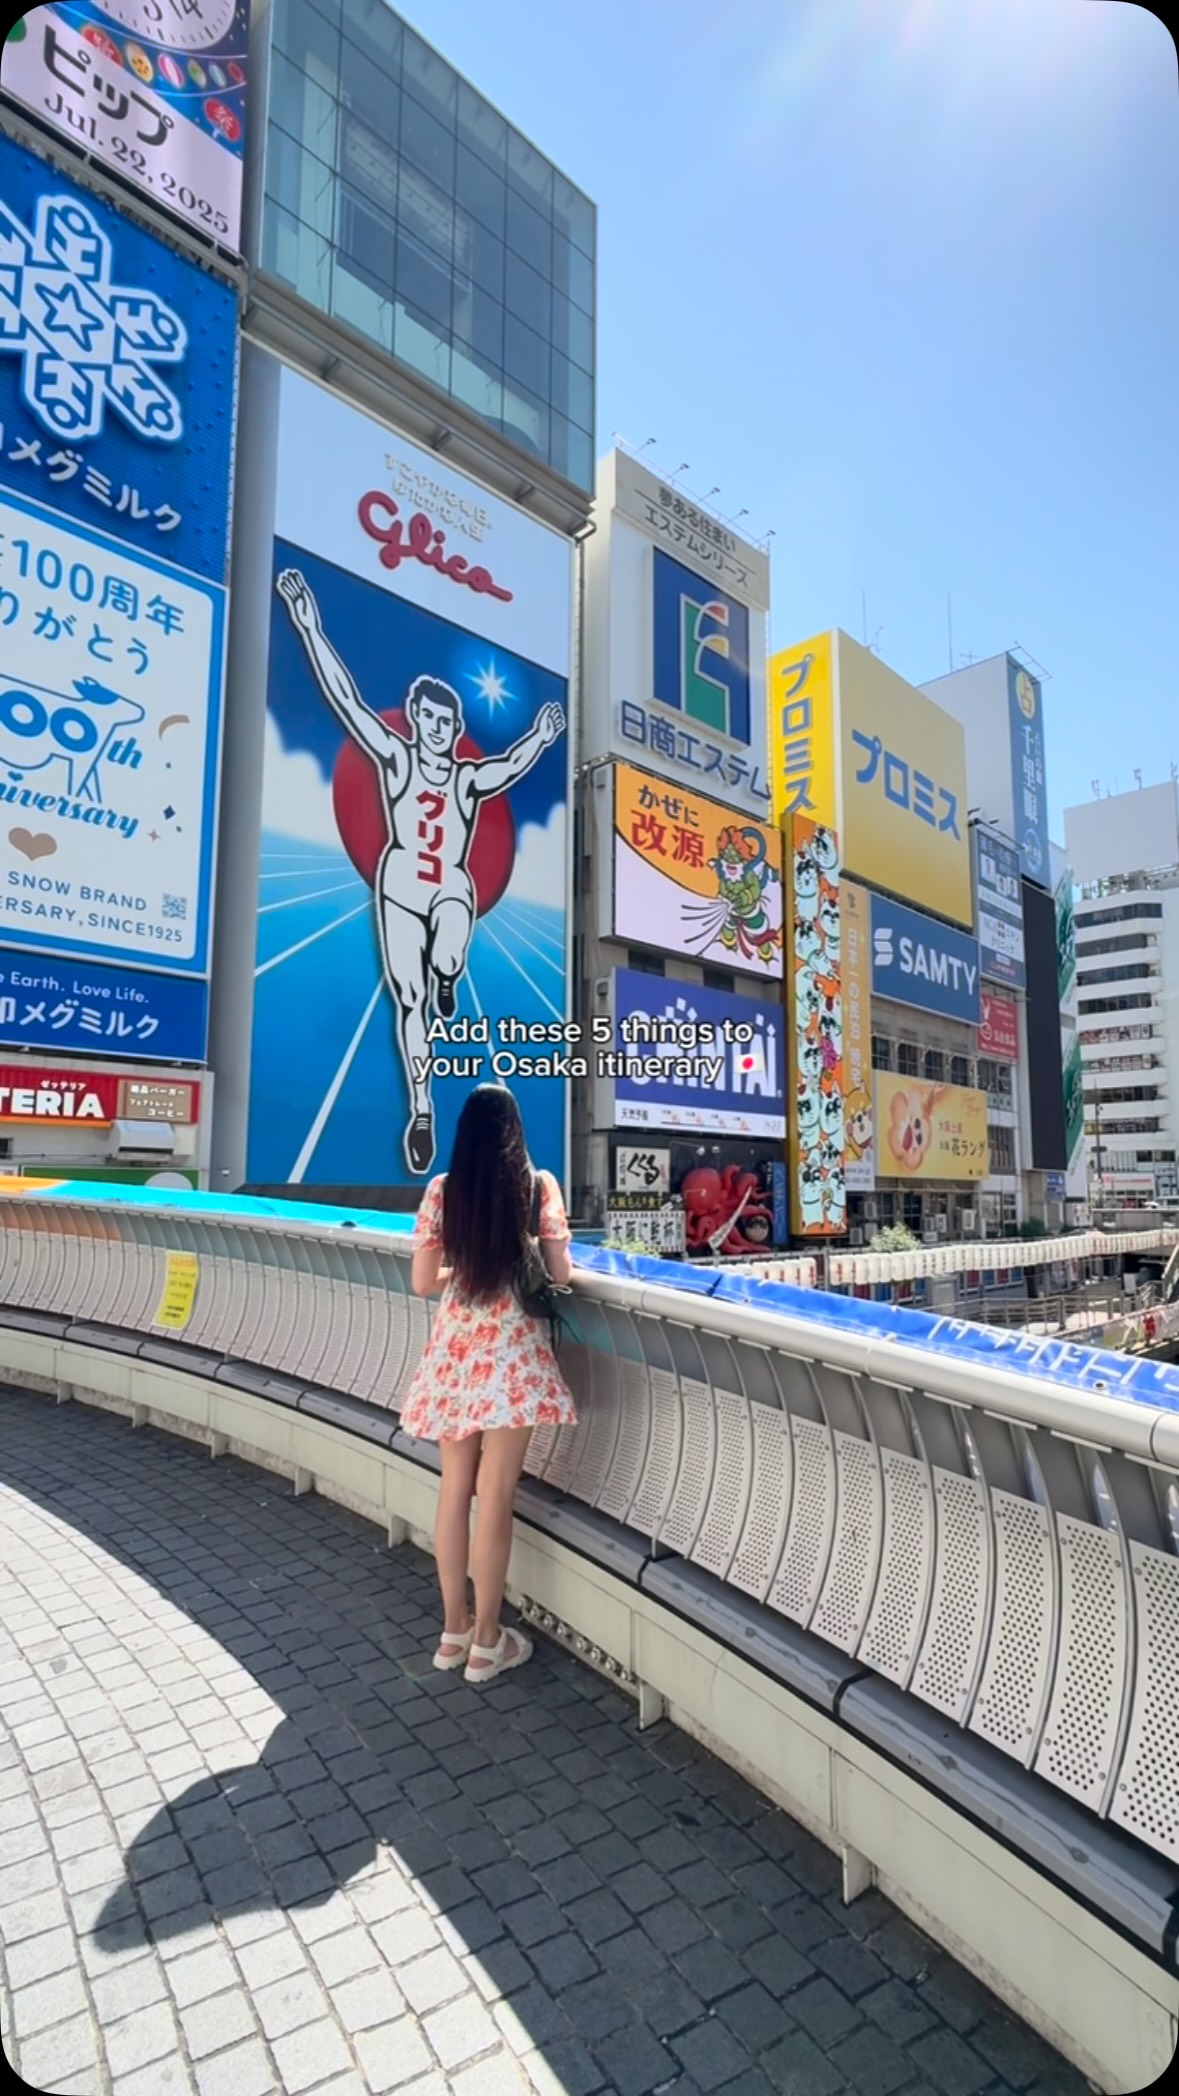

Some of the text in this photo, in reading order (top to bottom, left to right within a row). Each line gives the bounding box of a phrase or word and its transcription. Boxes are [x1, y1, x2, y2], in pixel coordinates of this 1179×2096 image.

[43, 24, 175, 147] ピップ
[43, 93, 229, 235] Jul. 22, 2025
[0, 421, 182, 531] メグミルク
[0, 533, 185, 636] 100周年
[358, 490, 513, 602] Glico
[621, 700, 772, 801] 日商エステム
[782, 653, 816, 813] プロミス
[639, 785, 699, 828] かぜに
[851, 727, 961, 842] プロミス
[416, 790, 447, 885] グリコ
[631, 809, 705, 869] 改源
[8, 870, 147, 911] SNOW BRAND
[10, 971, 65, 992] Earth.
[73, 980, 111, 999] Love
[116, 987, 149, 1004] Life.
[900, 937, 977, 996] SAMTY
[41, 1080, 87, 1091] ゼッテリア
[148, 1108, 185, 1118] コーヒー
